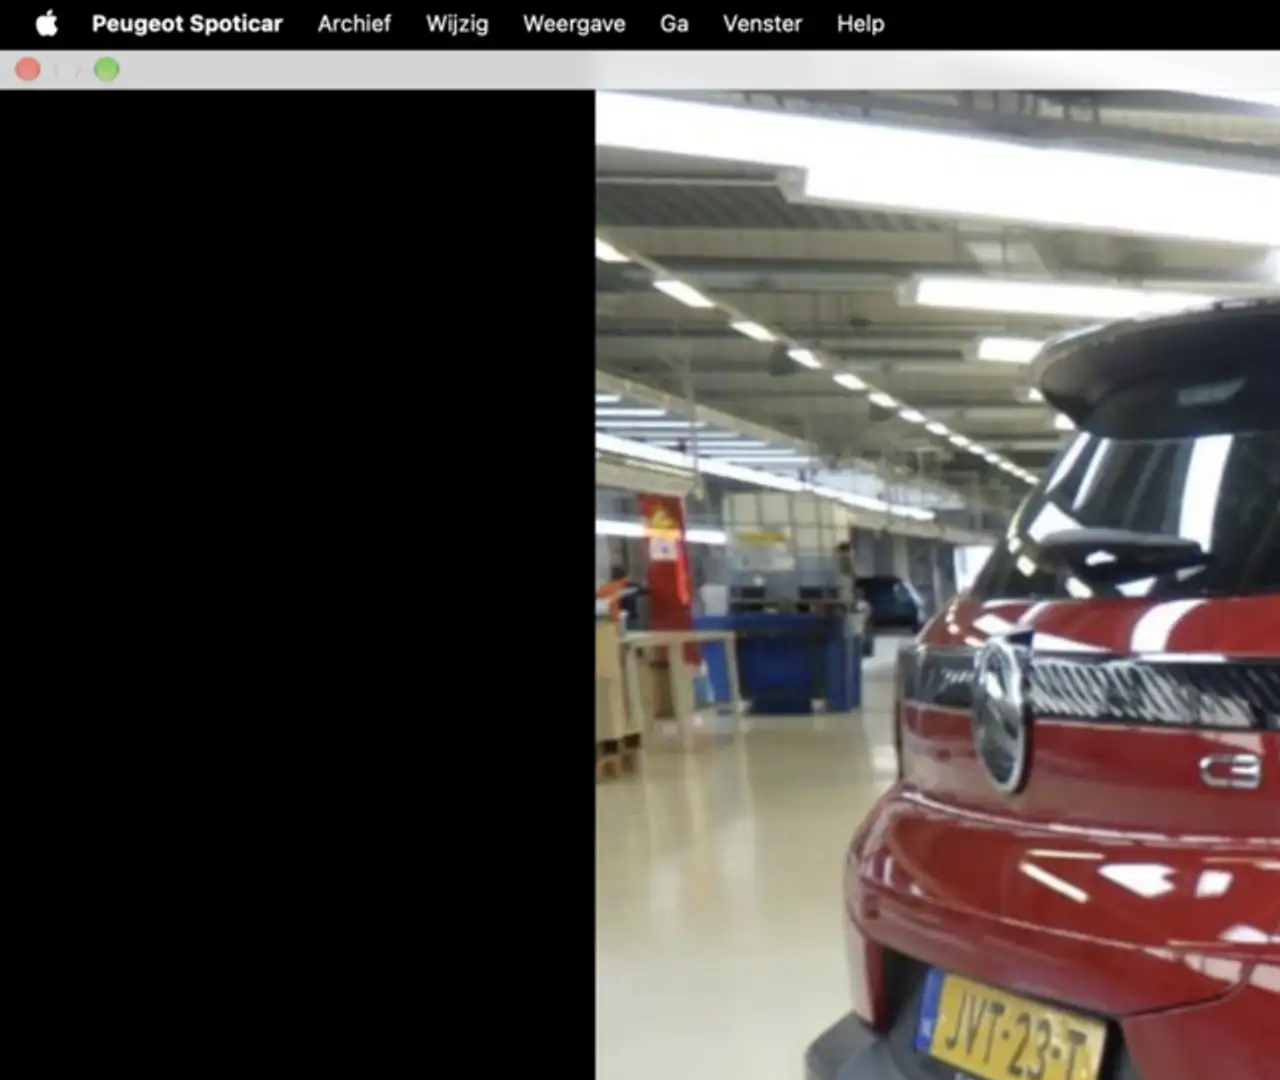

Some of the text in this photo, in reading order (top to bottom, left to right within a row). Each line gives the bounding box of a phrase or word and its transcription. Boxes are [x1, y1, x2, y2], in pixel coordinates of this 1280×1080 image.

[92, 13, 886, 37] Peugeot Spoticar Archief Wijzig Weergave Ga Venster Help
[1199, 754, 1260, 789] C3
